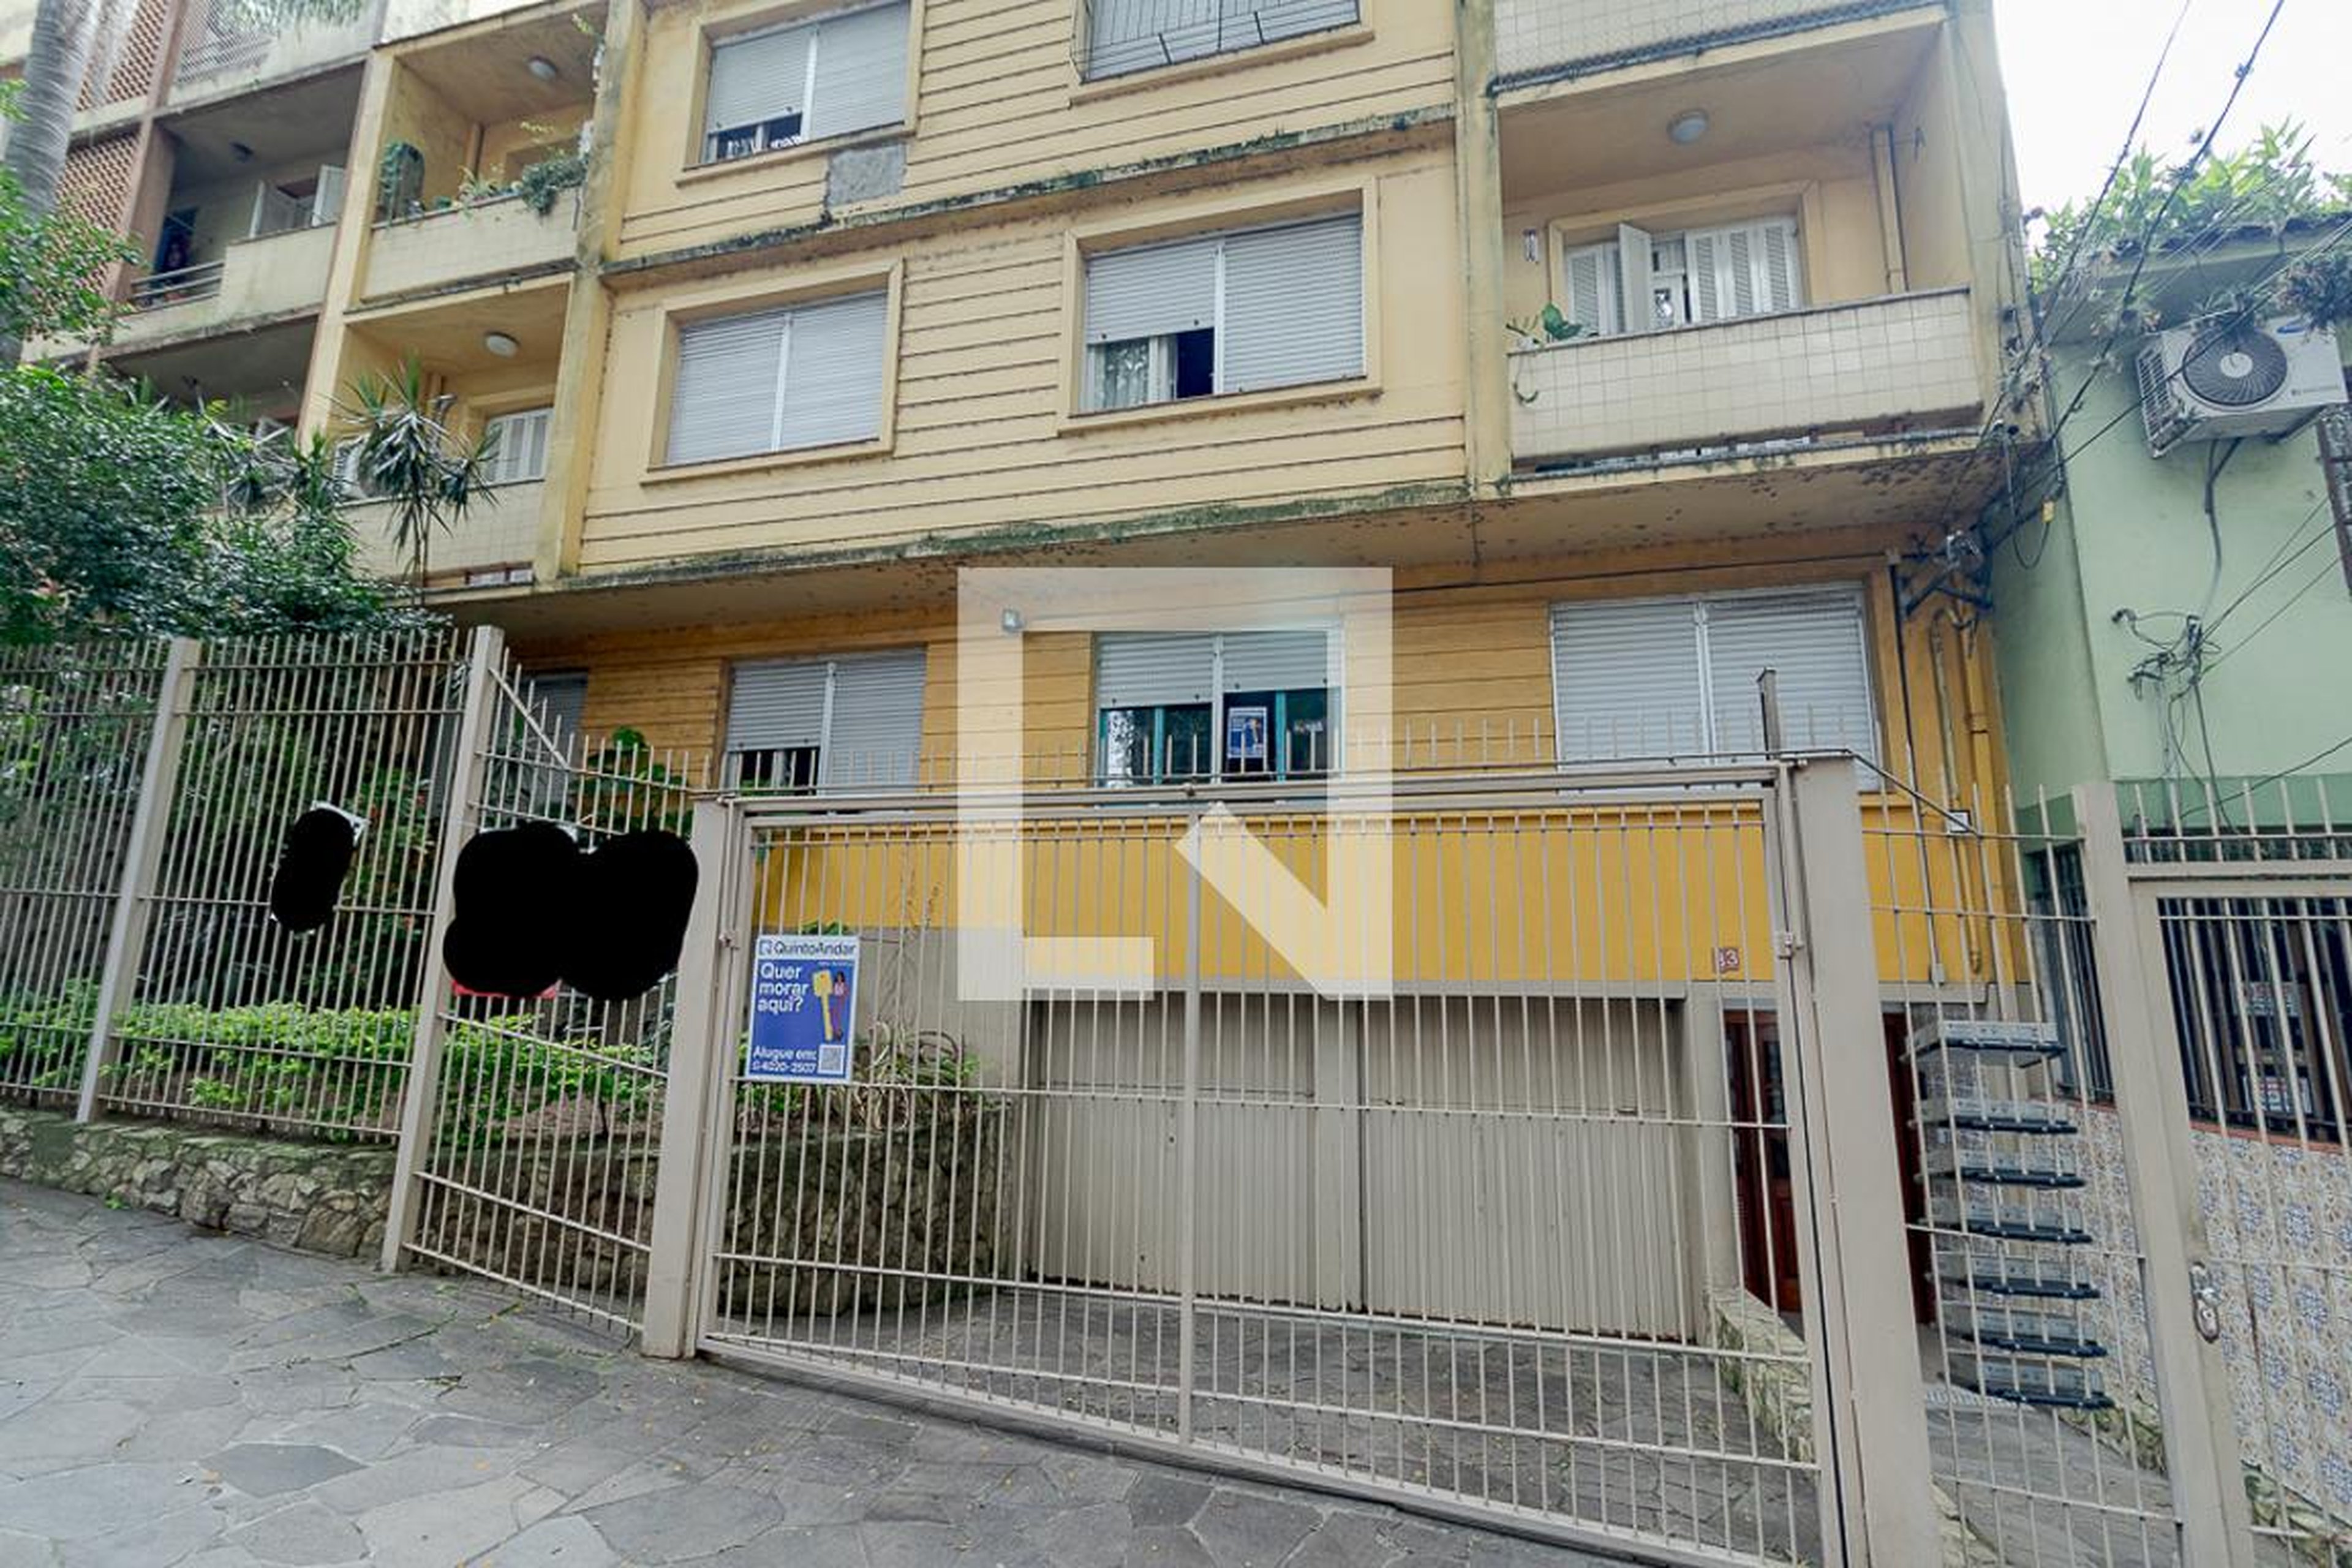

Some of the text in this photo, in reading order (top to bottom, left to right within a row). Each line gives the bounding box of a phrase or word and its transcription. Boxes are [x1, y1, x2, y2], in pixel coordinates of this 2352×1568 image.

[774, 941, 856, 955] QuintoAndar
[761, 962, 802, 979] Quer
[759, 982, 809, 996] morar
[757, 997, 804, 1015] aqui?
[753, 1046, 794, 1061] Alugue
